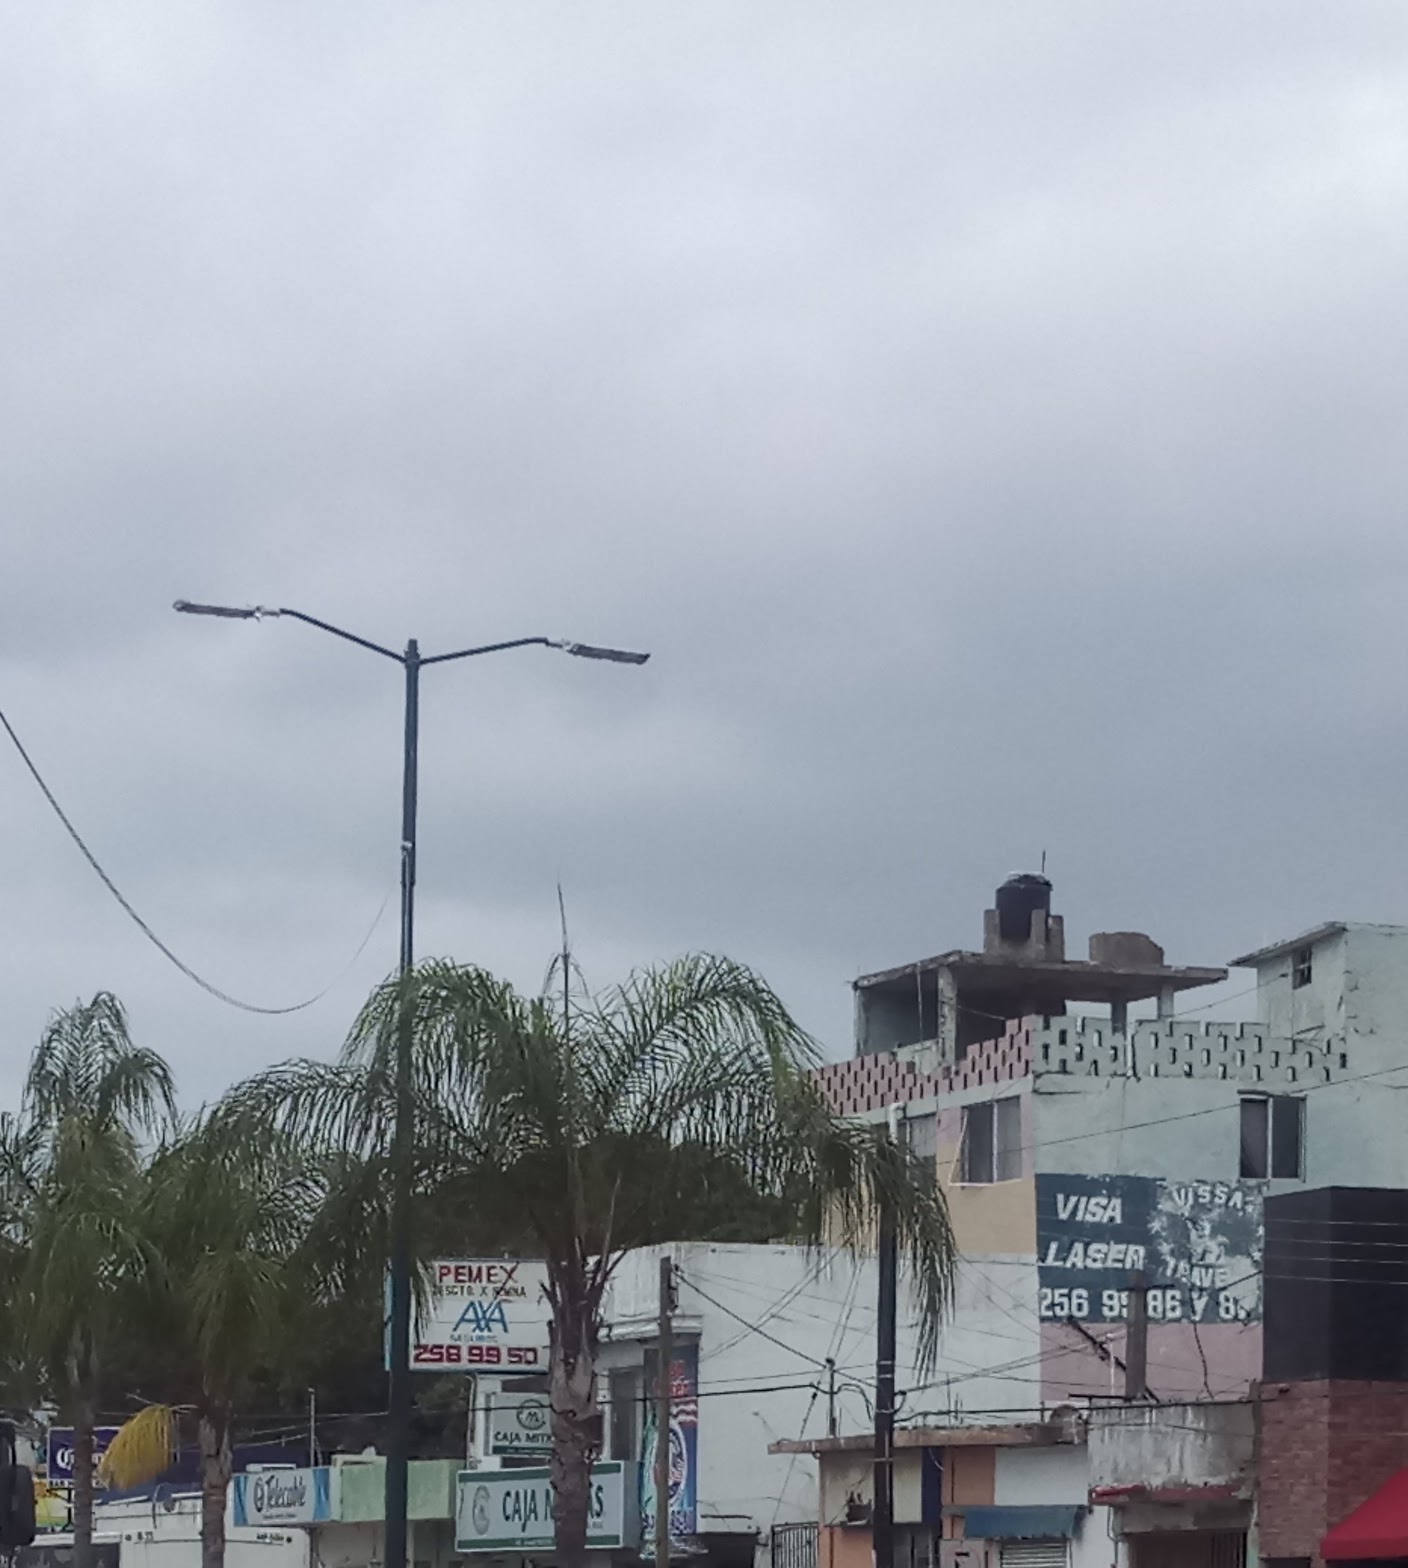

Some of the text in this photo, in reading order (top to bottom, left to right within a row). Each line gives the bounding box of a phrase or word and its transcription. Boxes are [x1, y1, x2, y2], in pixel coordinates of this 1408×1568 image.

[1055, 1193, 1123, 1225] VISA
[1044, 1240, 1147, 1271] LASER
[438, 1264, 519, 1285] PEMEX
[452, 1299, 510, 1334] AXA
[1039, 1288, 1090, 1318] 256
[467, 1346, 502, 1365] 99
[502, 1489, 539, 1533] CAJA
